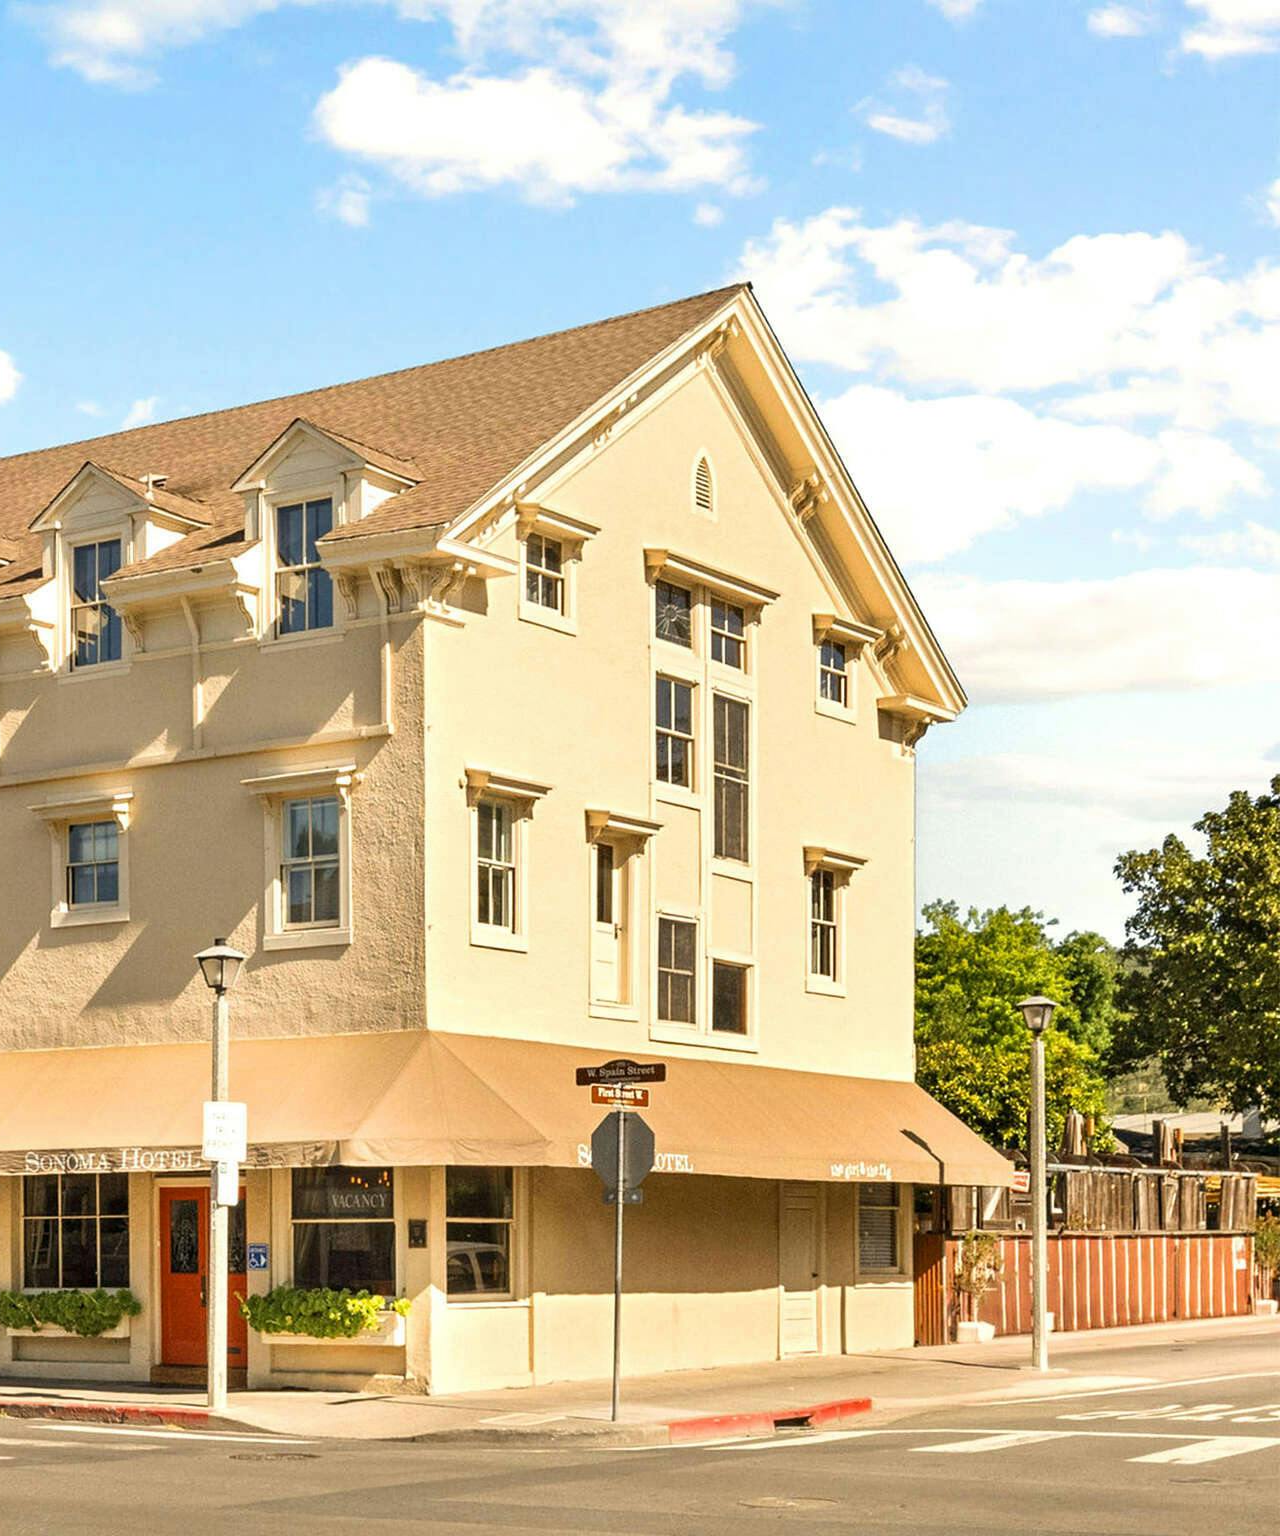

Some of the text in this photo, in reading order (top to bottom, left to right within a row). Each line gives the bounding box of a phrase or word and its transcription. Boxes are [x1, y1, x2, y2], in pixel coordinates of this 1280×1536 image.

[599, 1067, 625, 1078] Spain
[626, 1065, 656, 1076] Street
[598, 1087, 614, 1097] First
[650, 1150, 694, 1172] OTEL
[331, 1193, 386, 1209] VACANCY
